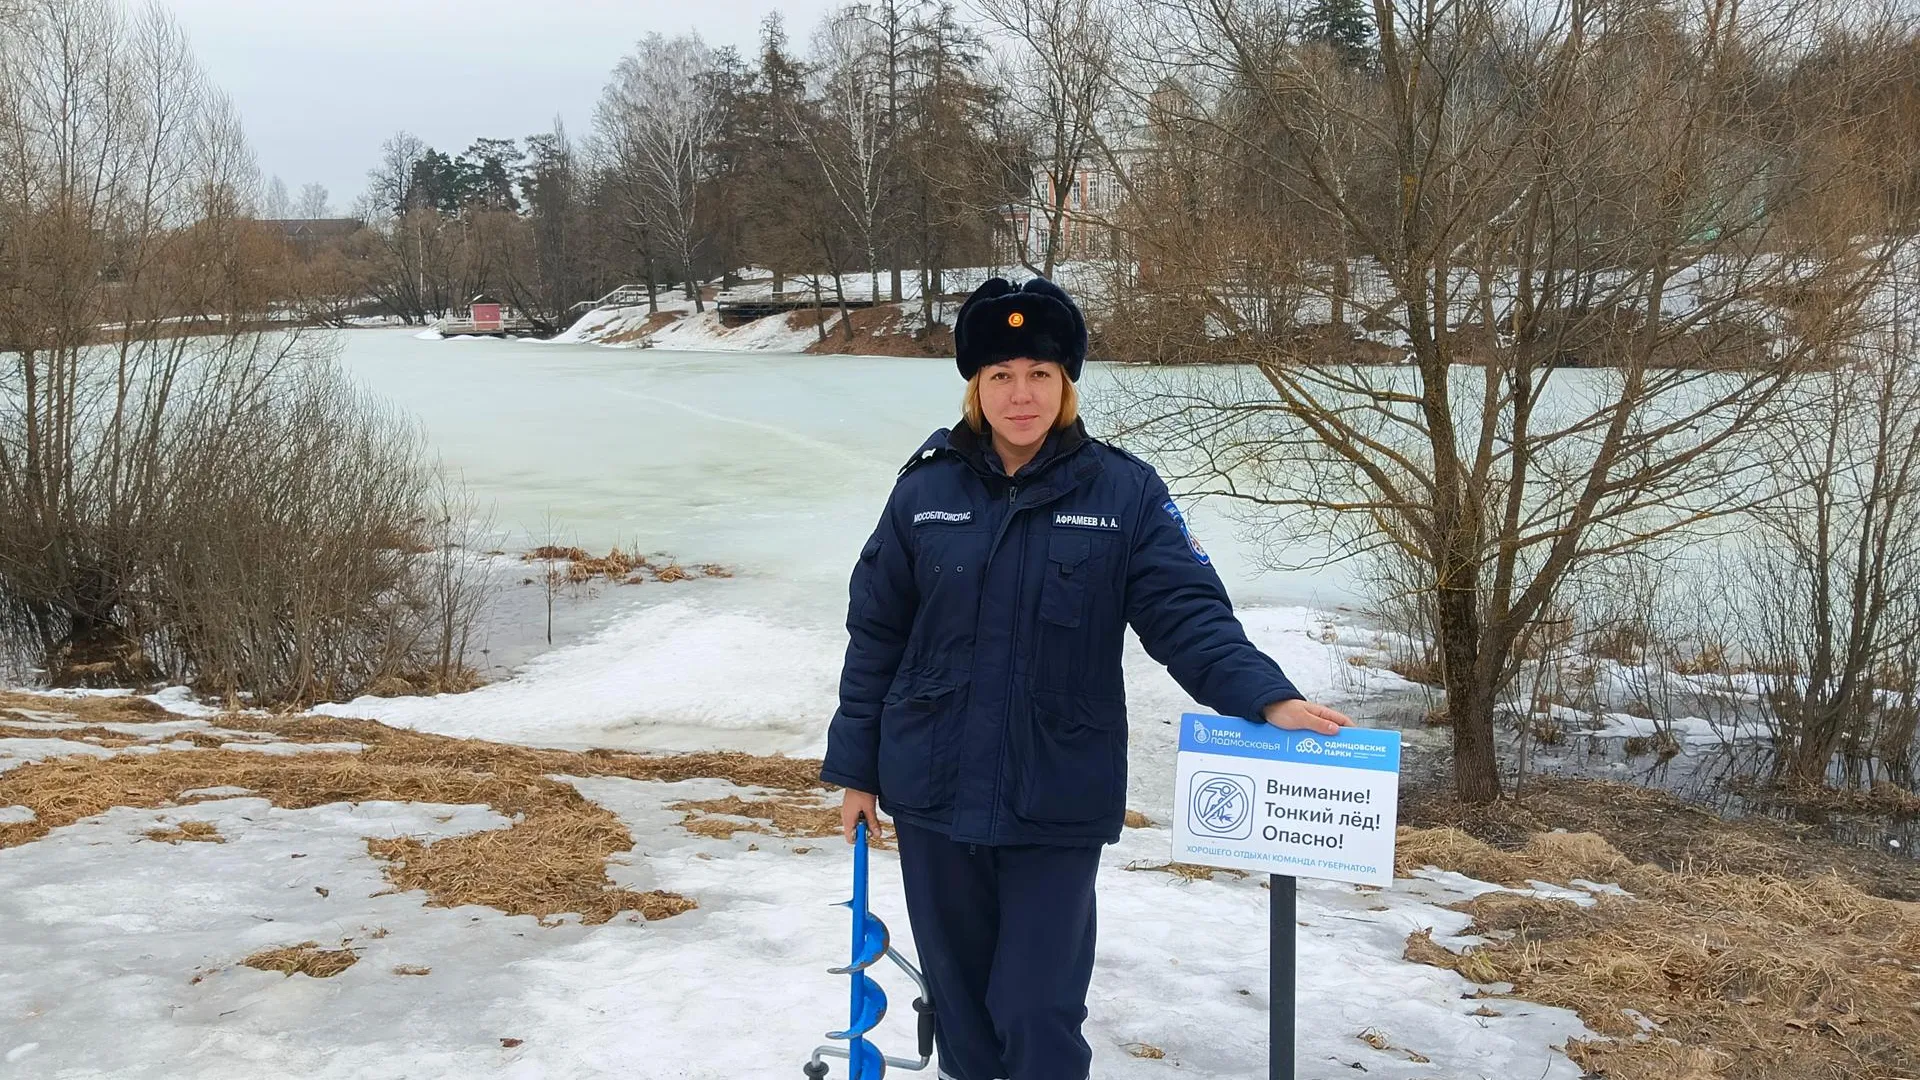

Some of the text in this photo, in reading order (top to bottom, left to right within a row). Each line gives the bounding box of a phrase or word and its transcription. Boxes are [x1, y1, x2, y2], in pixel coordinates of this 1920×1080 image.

[1055, 514, 1118, 528] АФРАМЕЕВ А. А.
[1211, 729, 1241, 739] ПАРКИ
[1210, 736, 1280, 751] ПОДМОСКОВЬЯ
[1324, 741, 1387, 753] ОДИНЦОВСКИЕ
[1324, 749, 1352, 758] ПАРКИ
[1266, 779, 1370, 804] Внимание!
[1265, 801, 1380, 831] Тонкий лёд!
[1262, 825, 1344, 849] Опасно!
[1186, 845, 1377, 874] ХОРОШЕГО ОТДЫХА! КОМАНДА ГУБЕРНАТОРА
